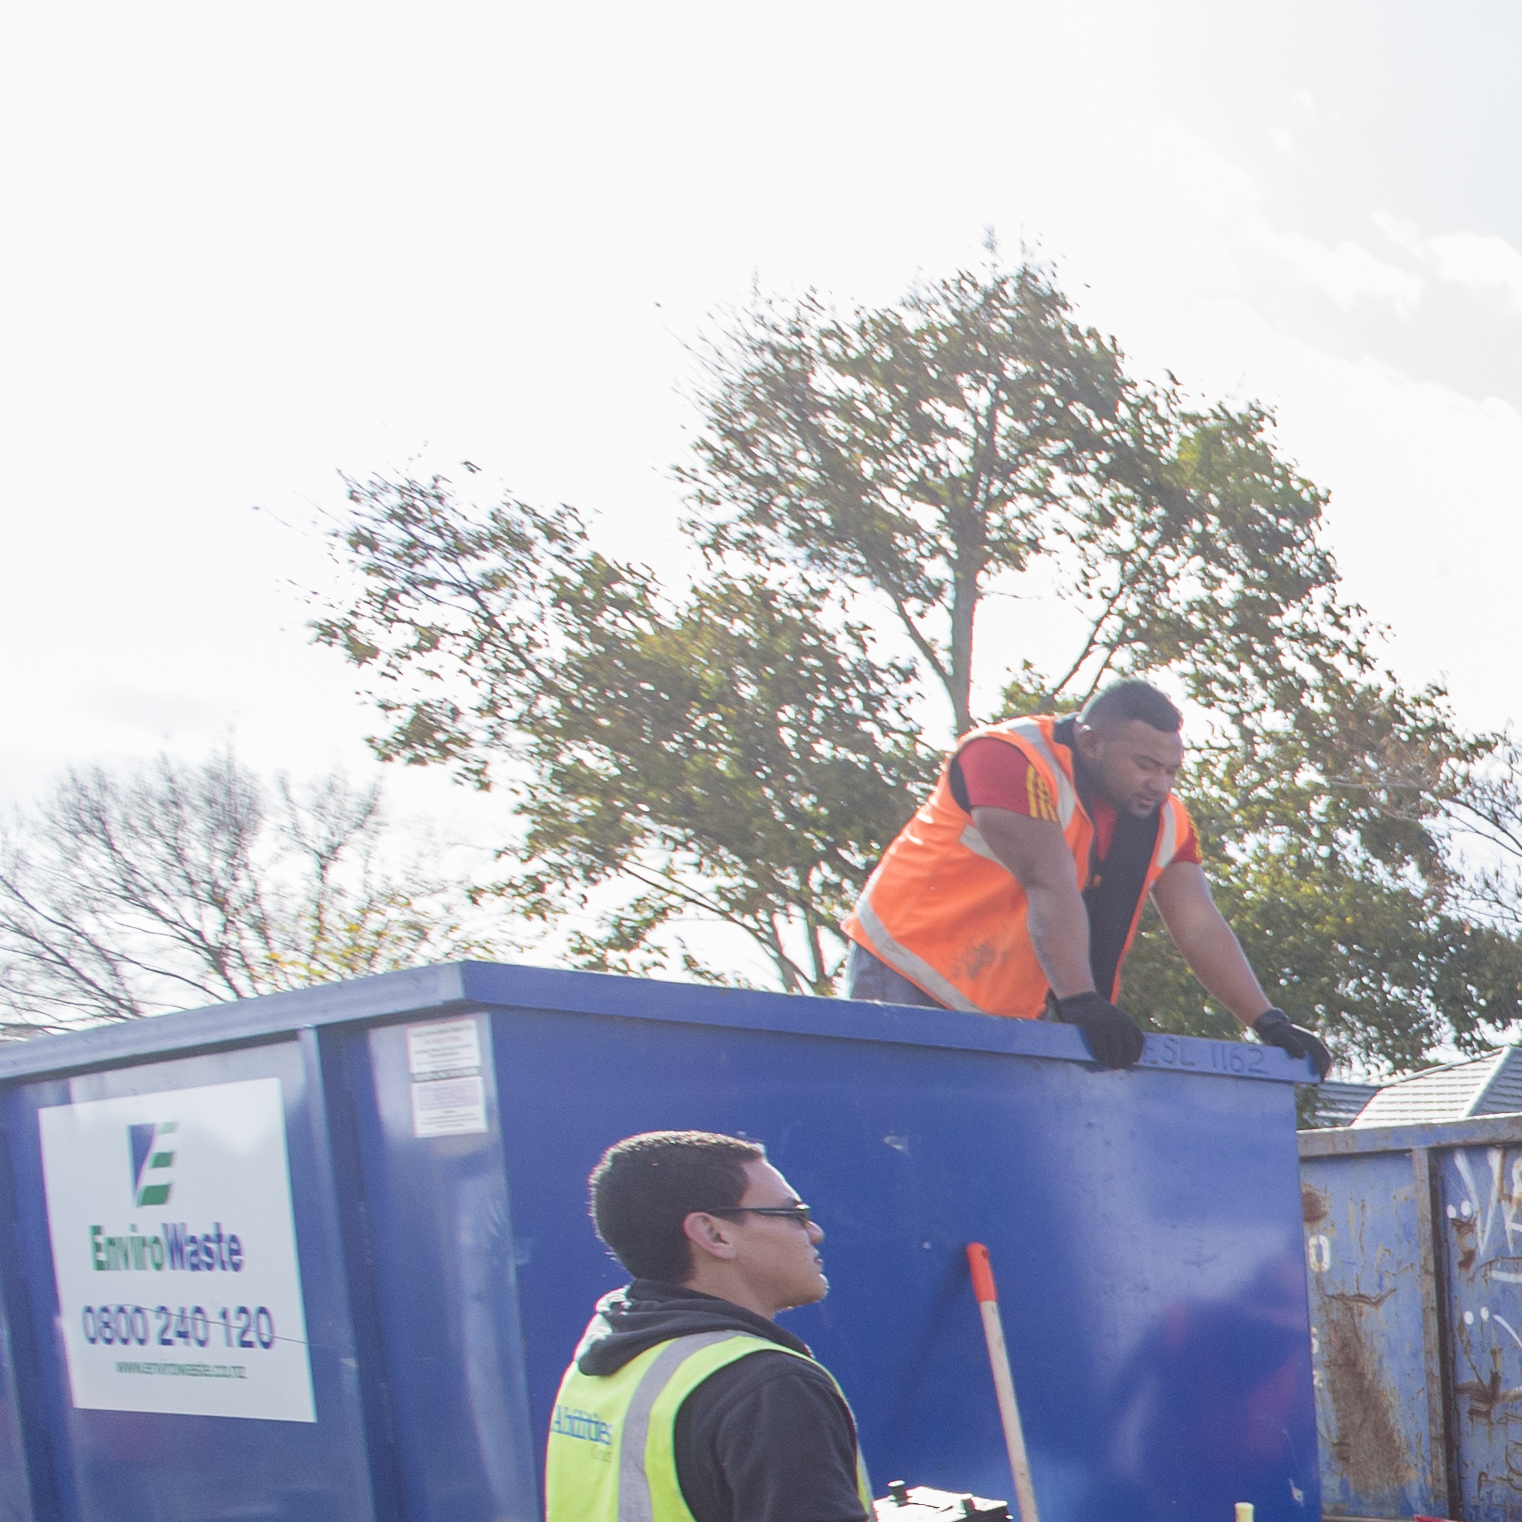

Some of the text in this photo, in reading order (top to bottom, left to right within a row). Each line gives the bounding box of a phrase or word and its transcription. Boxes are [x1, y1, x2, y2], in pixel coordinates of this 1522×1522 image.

[88, 1221, 245, 1273] EnviroWaste
[82, 1305, 275, 1350] 0800 240 120
